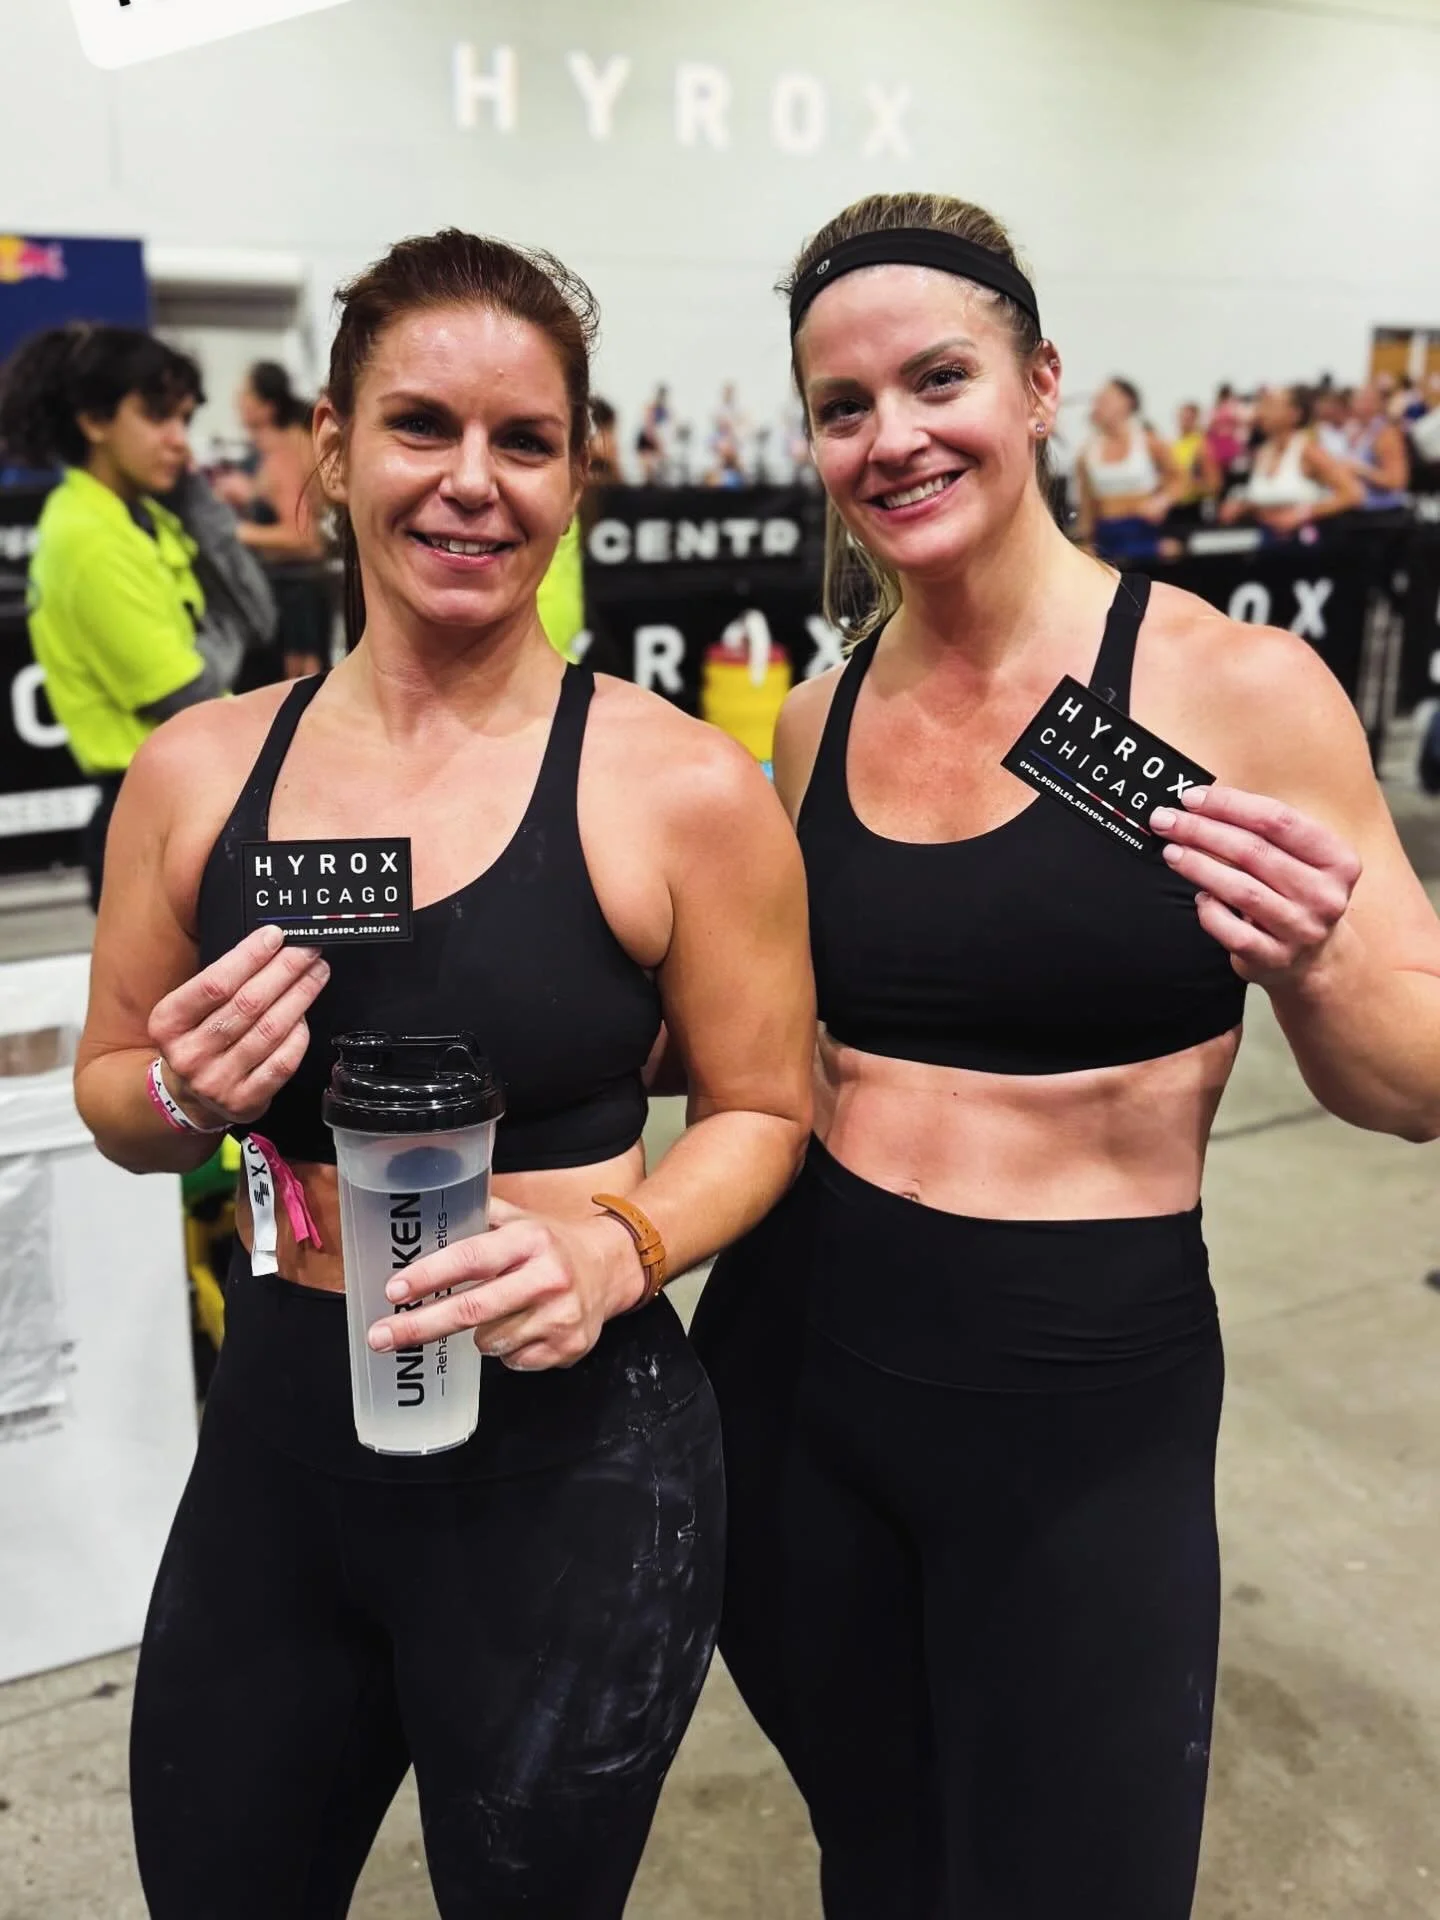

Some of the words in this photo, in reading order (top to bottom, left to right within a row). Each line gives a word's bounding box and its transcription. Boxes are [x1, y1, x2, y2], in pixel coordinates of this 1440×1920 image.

[453, 40, 912, 161] HYROX
[1040, 727, 1148, 810] CHICAG
[1057, 696, 1194, 800] HYROX
[255, 851, 398, 877] HYROX
[256, 886, 398, 907] CHICAGO
